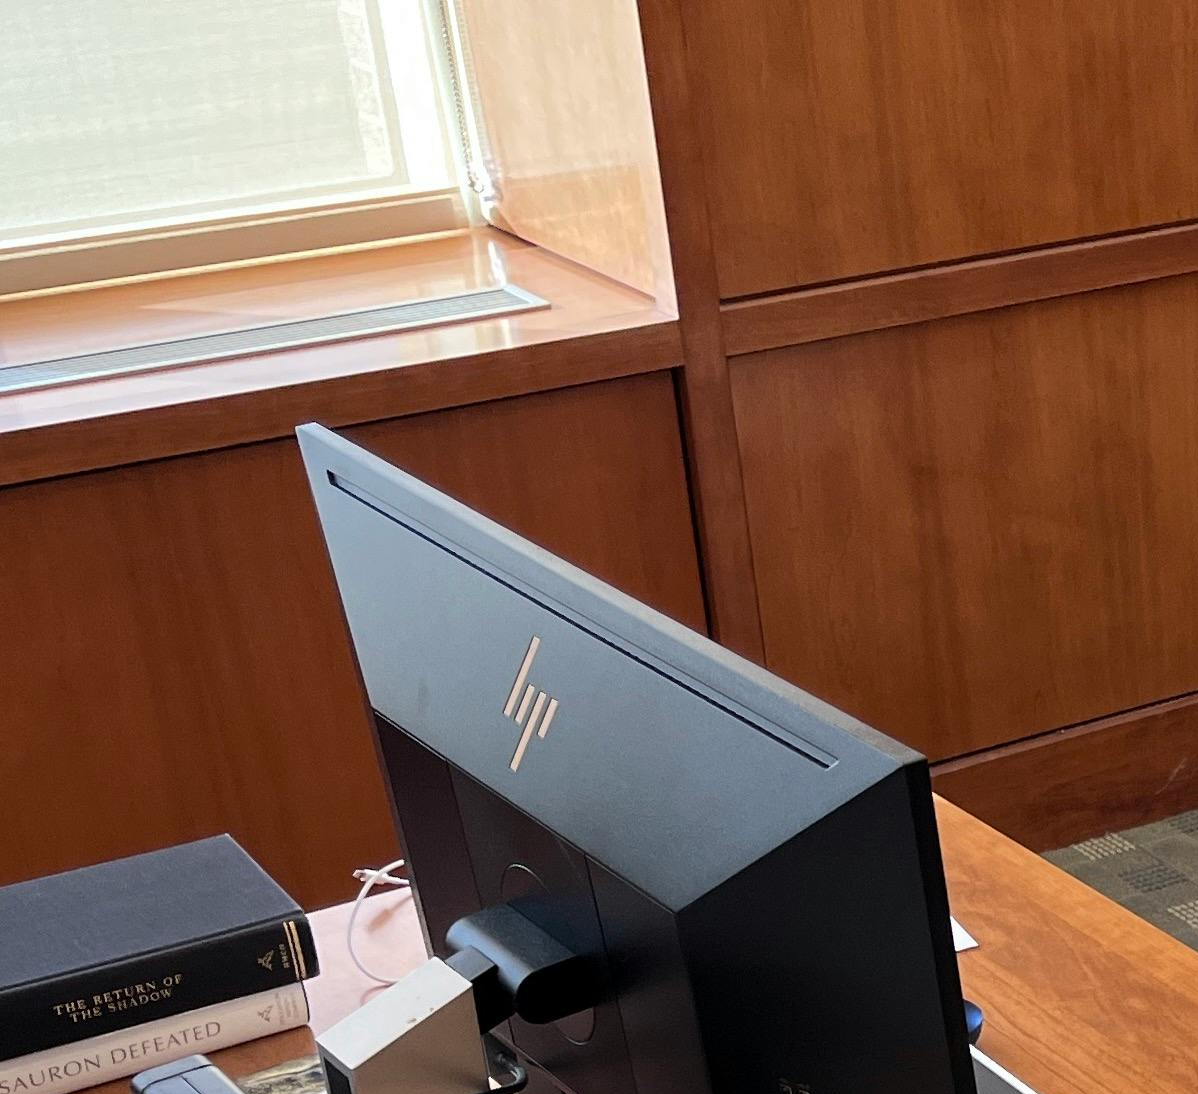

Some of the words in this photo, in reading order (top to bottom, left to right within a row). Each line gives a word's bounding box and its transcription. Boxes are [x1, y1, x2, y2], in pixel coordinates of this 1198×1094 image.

[53, 999, 87, 1016] THE
[92, 980, 156, 1006] RETURN
[163, 973, 182, 987] OF
[70, 1006, 102, 1023] THE
[107, 988, 172, 1013] SHADOW
[111, 1021, 221, 1065] DEFEATED
